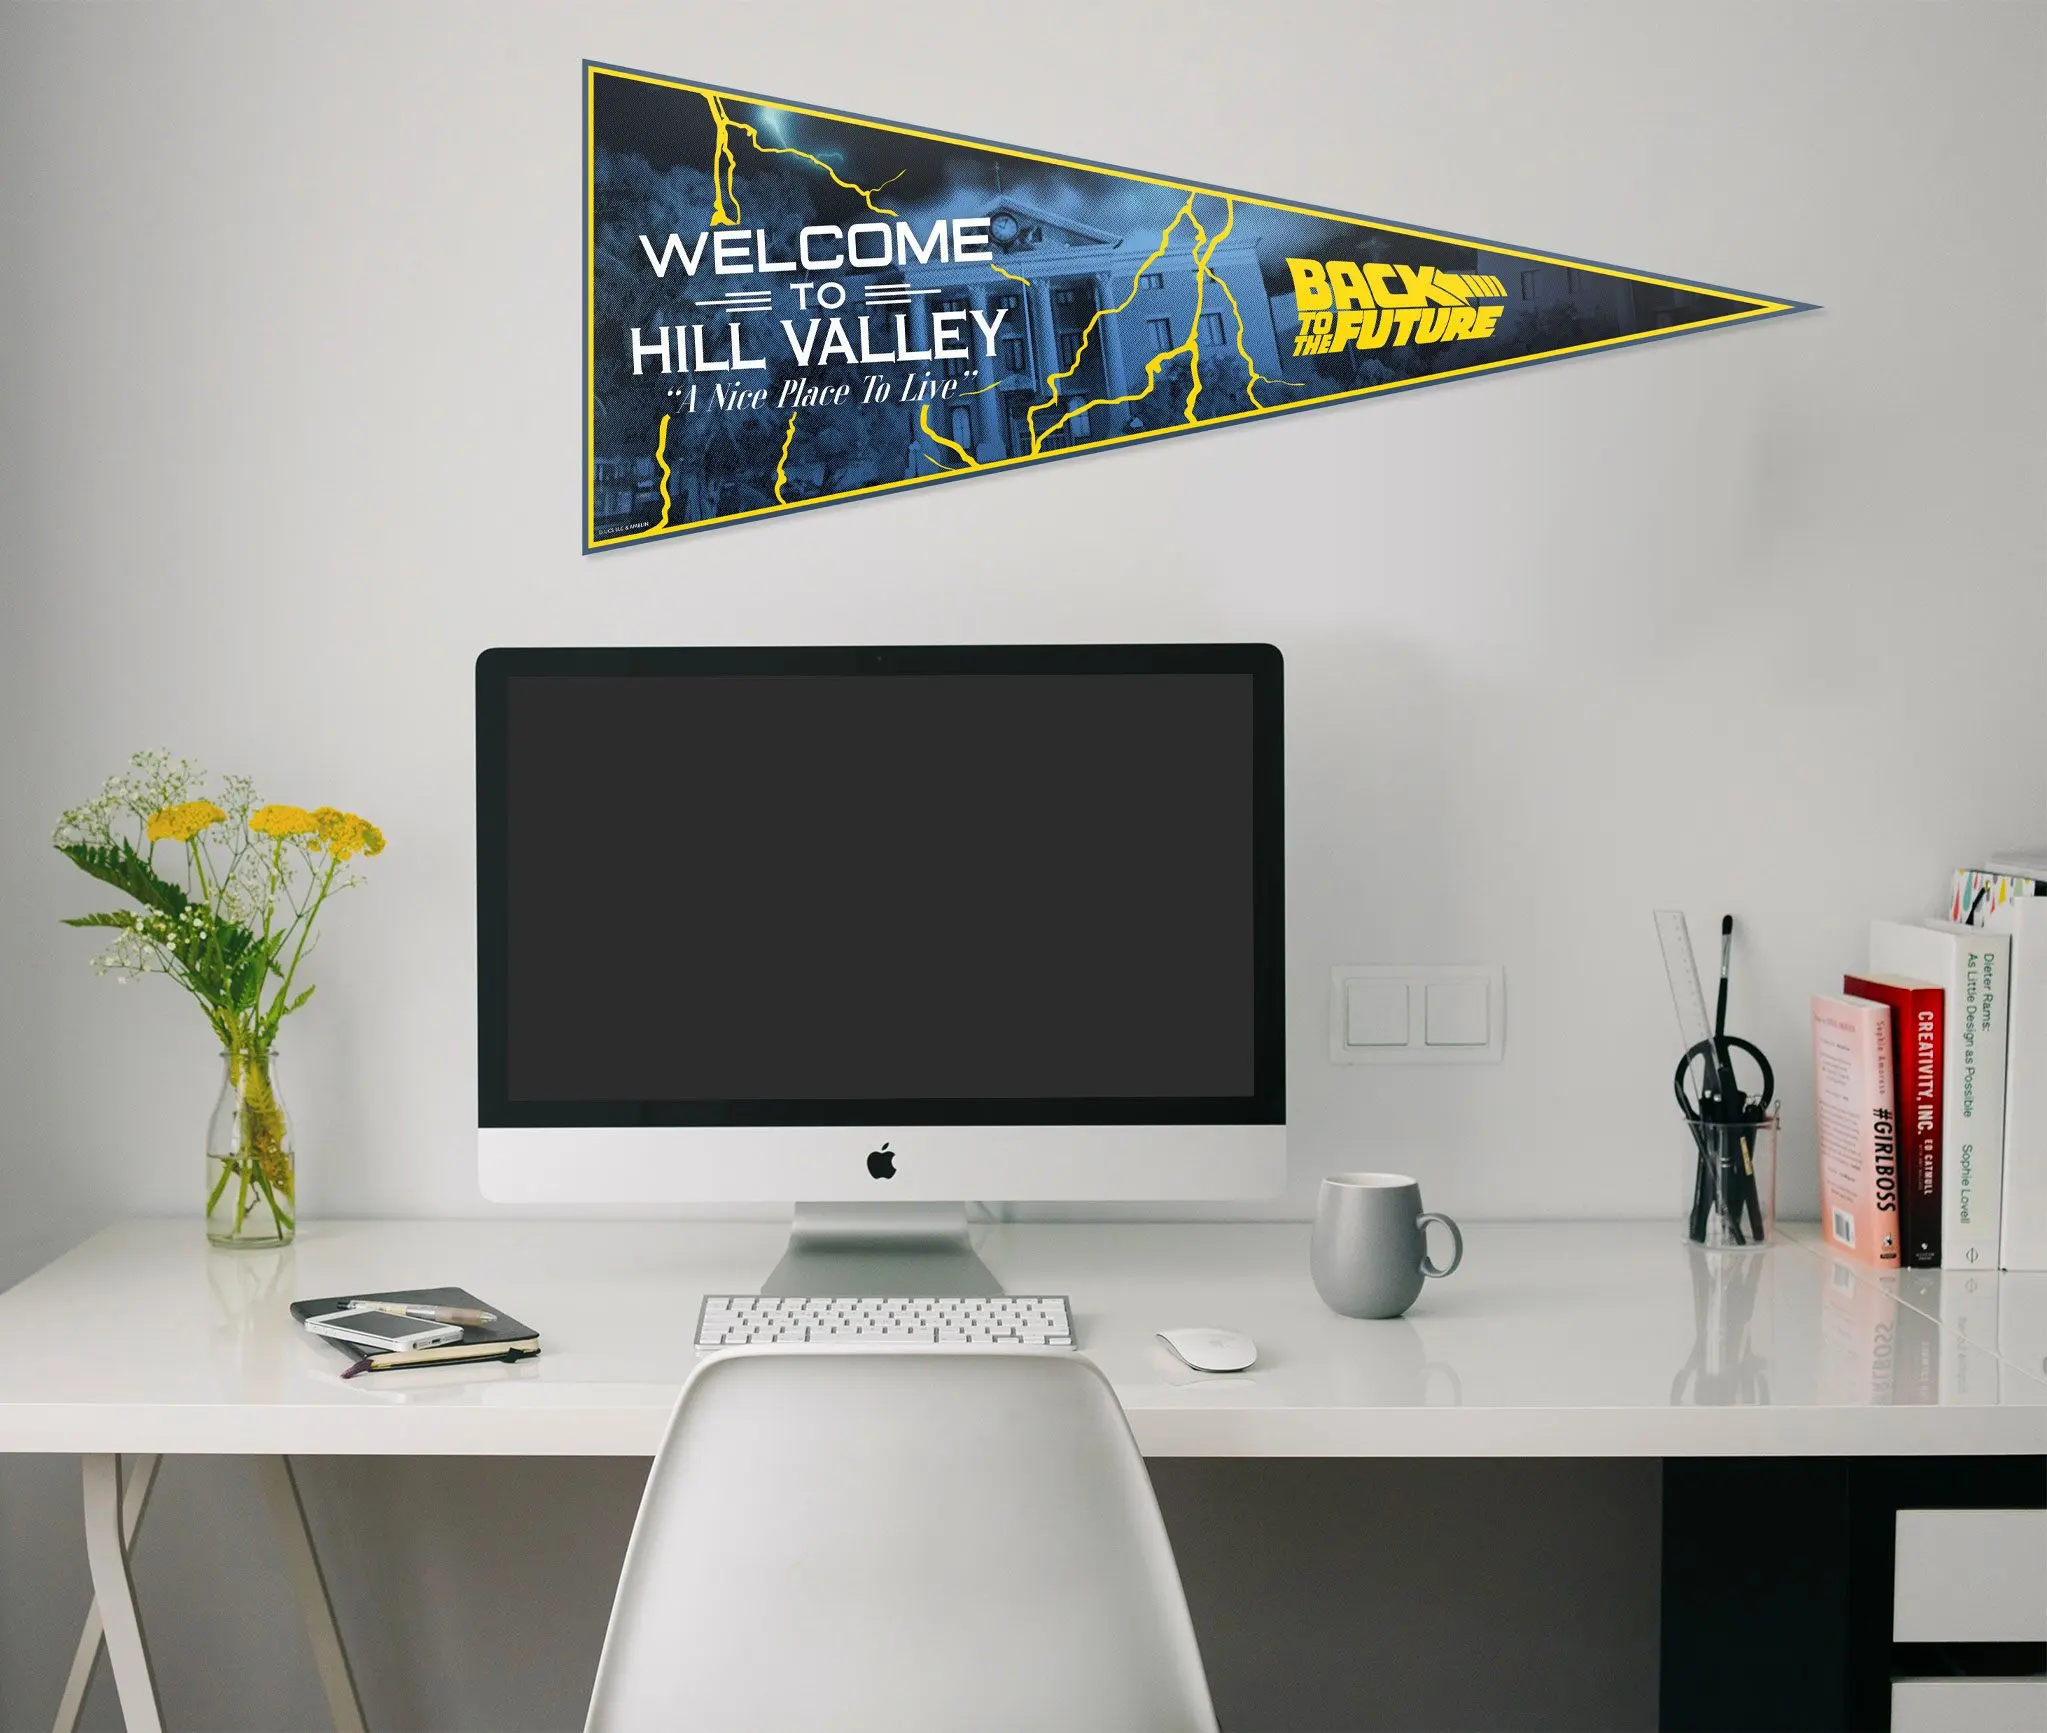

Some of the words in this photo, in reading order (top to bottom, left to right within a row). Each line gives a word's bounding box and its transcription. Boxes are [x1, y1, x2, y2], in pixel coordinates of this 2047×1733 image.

[639, 218, 993, 278] WELCOME
[790, 282, 846, 310] TO
[1286, 258, 1471, 311] BACK
[630, 322, 766, 376] HILL
[781, 309, 1008, 367] VALLEY
[1298, 311, 1333, 336] TO
[1330, 305, 1504, 353] FUTURE
[1292, 334, 1334, 357] THE
[667, 385, 697, 413] “A
[708, 381, 768, 412] Nice
[777, 379, 850, 408] Place
[861, 375, 891, 404] To
[900, 370, 978, 402] Live”
[1968, 953, 1978, 968] As
[1983, 953, 1995, 991] Dieter
[1966, 971, 1977, 1002] Little
[1963, 1005, 1977, 1047] Design
[1982, 994, 1993, 1032] Rams:
[1916, 1011, 1934, 1101] CREATIVITY,
[1965, 1050, 1974, 1064] as
[1963, 1067, 1976, 1118] Possible
[1917, 1104, 1933, 1135] INC.
[1873, 1108, 1897, 1213] #GIRLBOSS
[1924, 1139, 1933, 1151] ED
[1960, 1144, 1973, 1186] Sophie
[1924, 1153, 1933, 1196] CATMULL
[1960, 1189, 1972, 1224] Lovell
